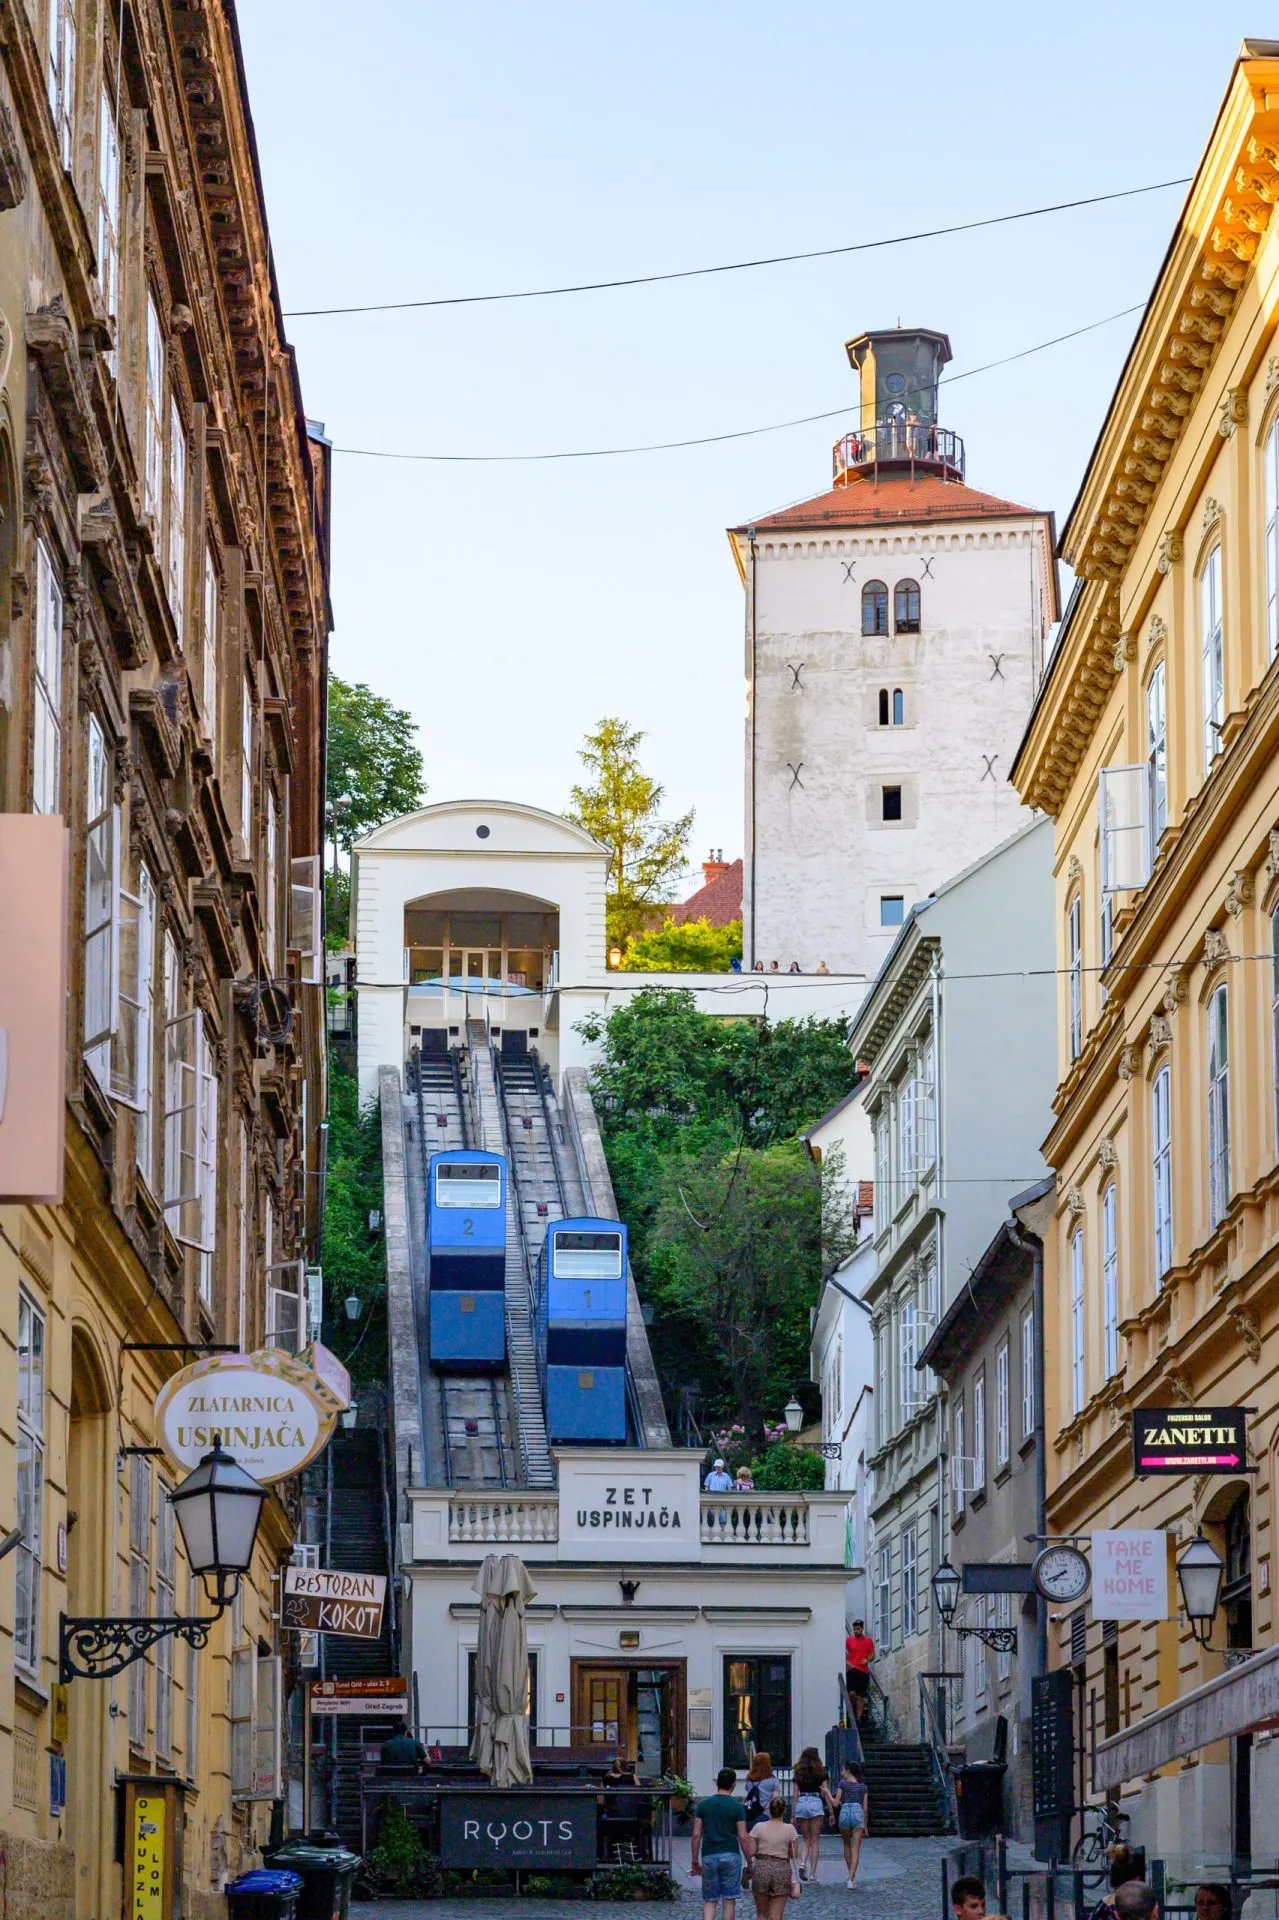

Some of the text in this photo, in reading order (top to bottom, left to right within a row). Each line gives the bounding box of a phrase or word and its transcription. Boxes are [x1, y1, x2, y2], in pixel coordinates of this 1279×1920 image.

[463, 1218, 474, 1236] 2
[583, 1290, 592, 1308] 1
[188, 1397, 295, 1412] ZLATARNICA
[177, 1420, 306, 1449] USPINJAČA
[1143, 1427, 1237, 1445] ZANETTI
[606, 1488, 652, 1505] ZET
[577, 1506, 681, 1528] USPINJAČA
[1105, 1540, 1152, 1556] TAKE
[1115, 1559, 1143, 1575] ME
[294, 1573, 375, 1597] RESTORAN
[1104, 1578, 1156, 1594] HOME
[318, 1601, 379, 1635] KOKOT
[381, 1703, 403, 1711] Zagreb
[150, 1854, 159, 1896] LOM
